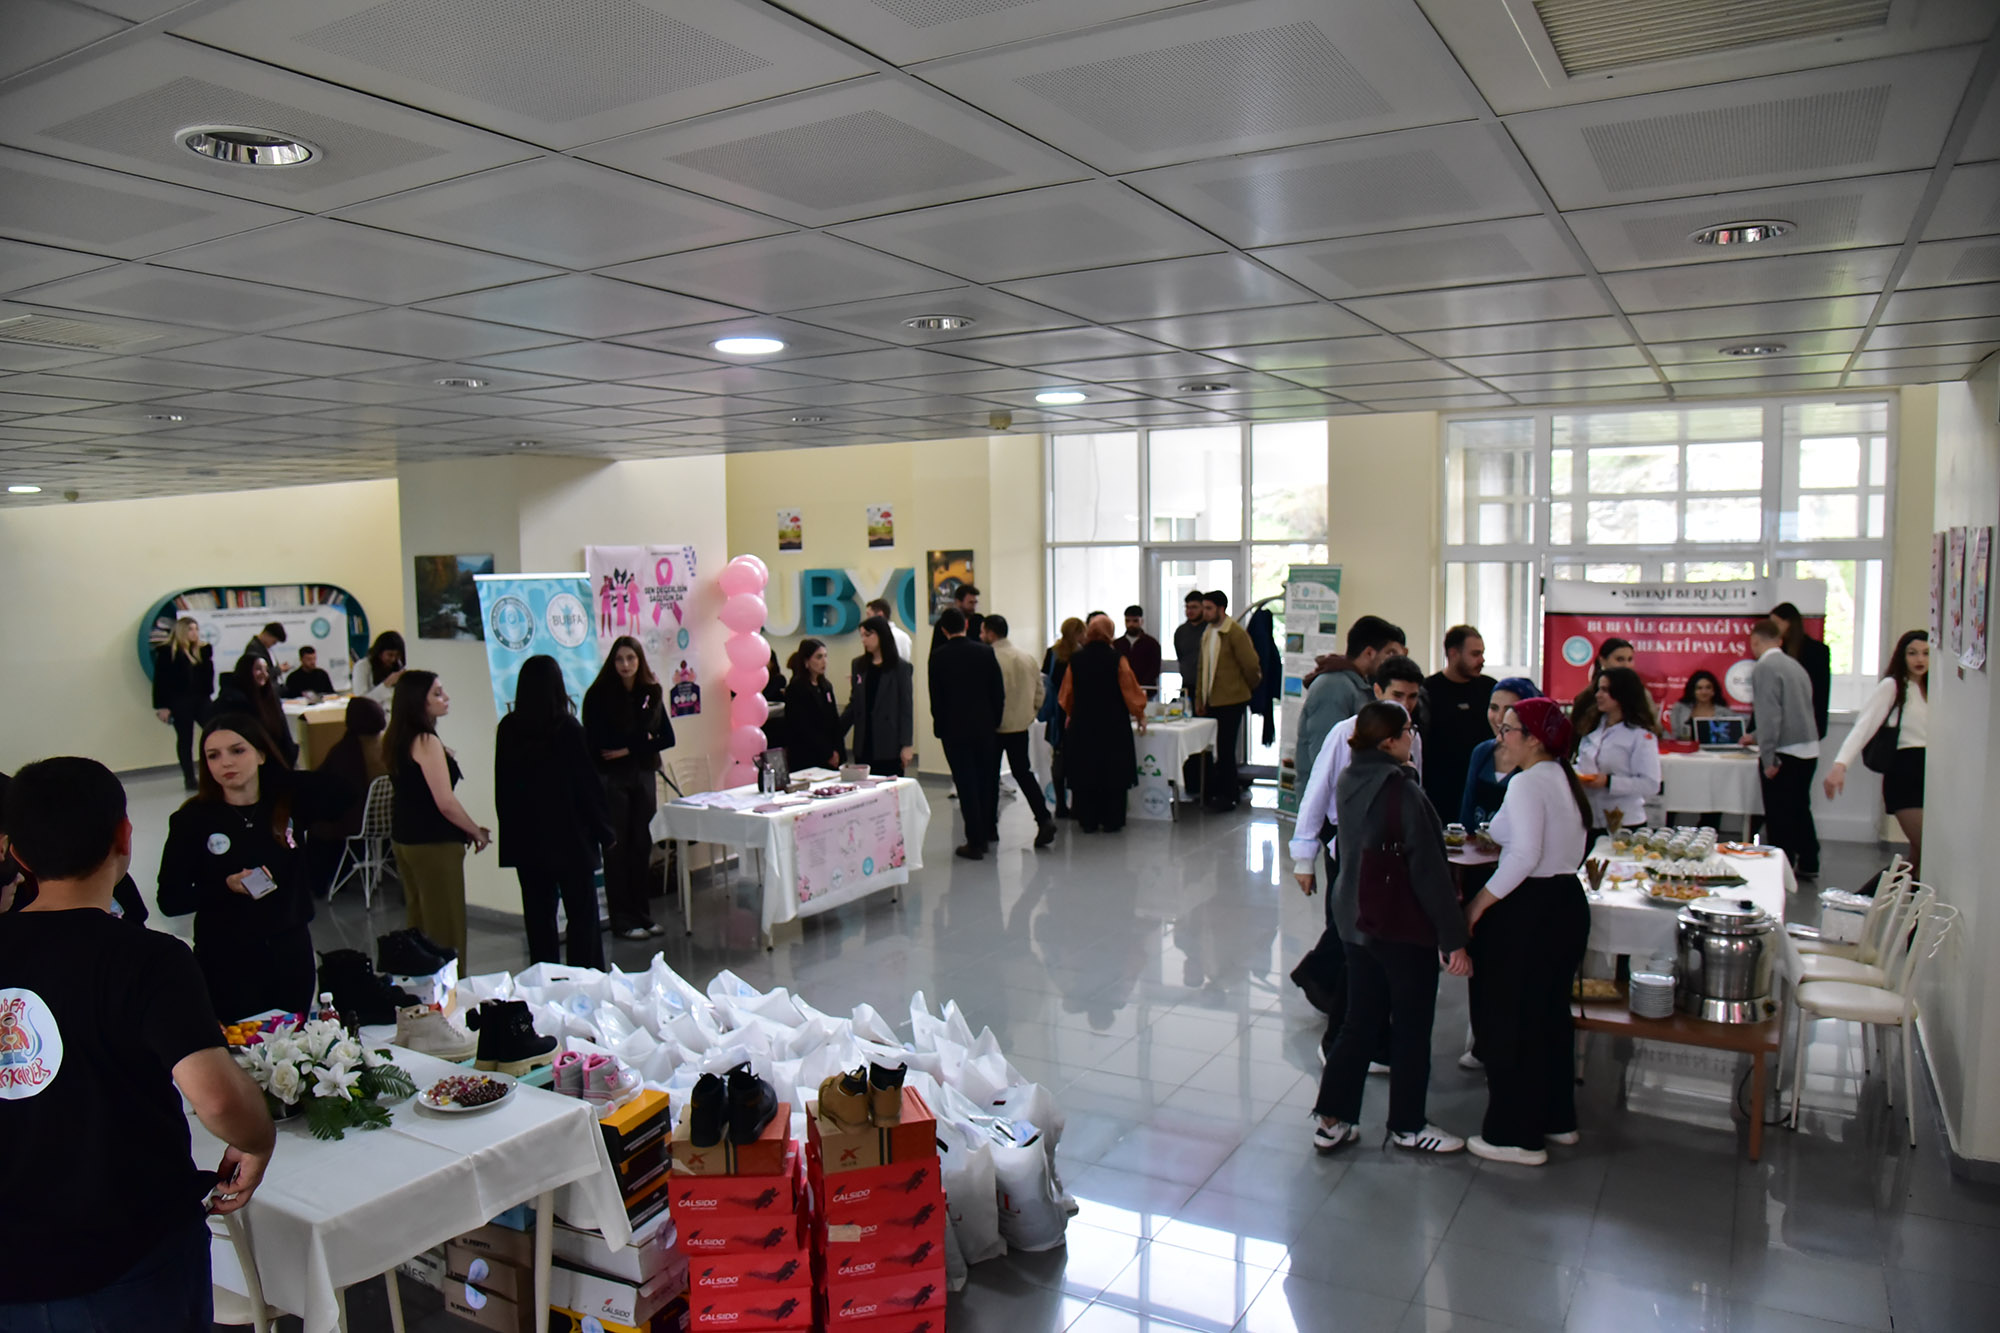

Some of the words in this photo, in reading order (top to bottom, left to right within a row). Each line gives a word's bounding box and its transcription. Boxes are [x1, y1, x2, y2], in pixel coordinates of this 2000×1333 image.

[552, 614, 585, 626] BUBFA
[1633, 618, 1657, 634] İLE
[1658, 618, 1730, 635] GELENEĞİ
[1693, 640, 1746, 657] PAYLAŞ
[832, 1188, 871, 1203] CALSIDO
[678, 1199, 718, 1208] CALSIDO
[687, 1238, 726, 1246] CALSIDO
[838, 1262, 876, 1275] CALSIDO
[698, 1276, 739, 1286] CALSIDO
[601, 1305, 631, 1319] CALSIDO
[699, 1312, 739, 1322] CALSIDO
[839, 1304, 878, 1317] CALSIDO
